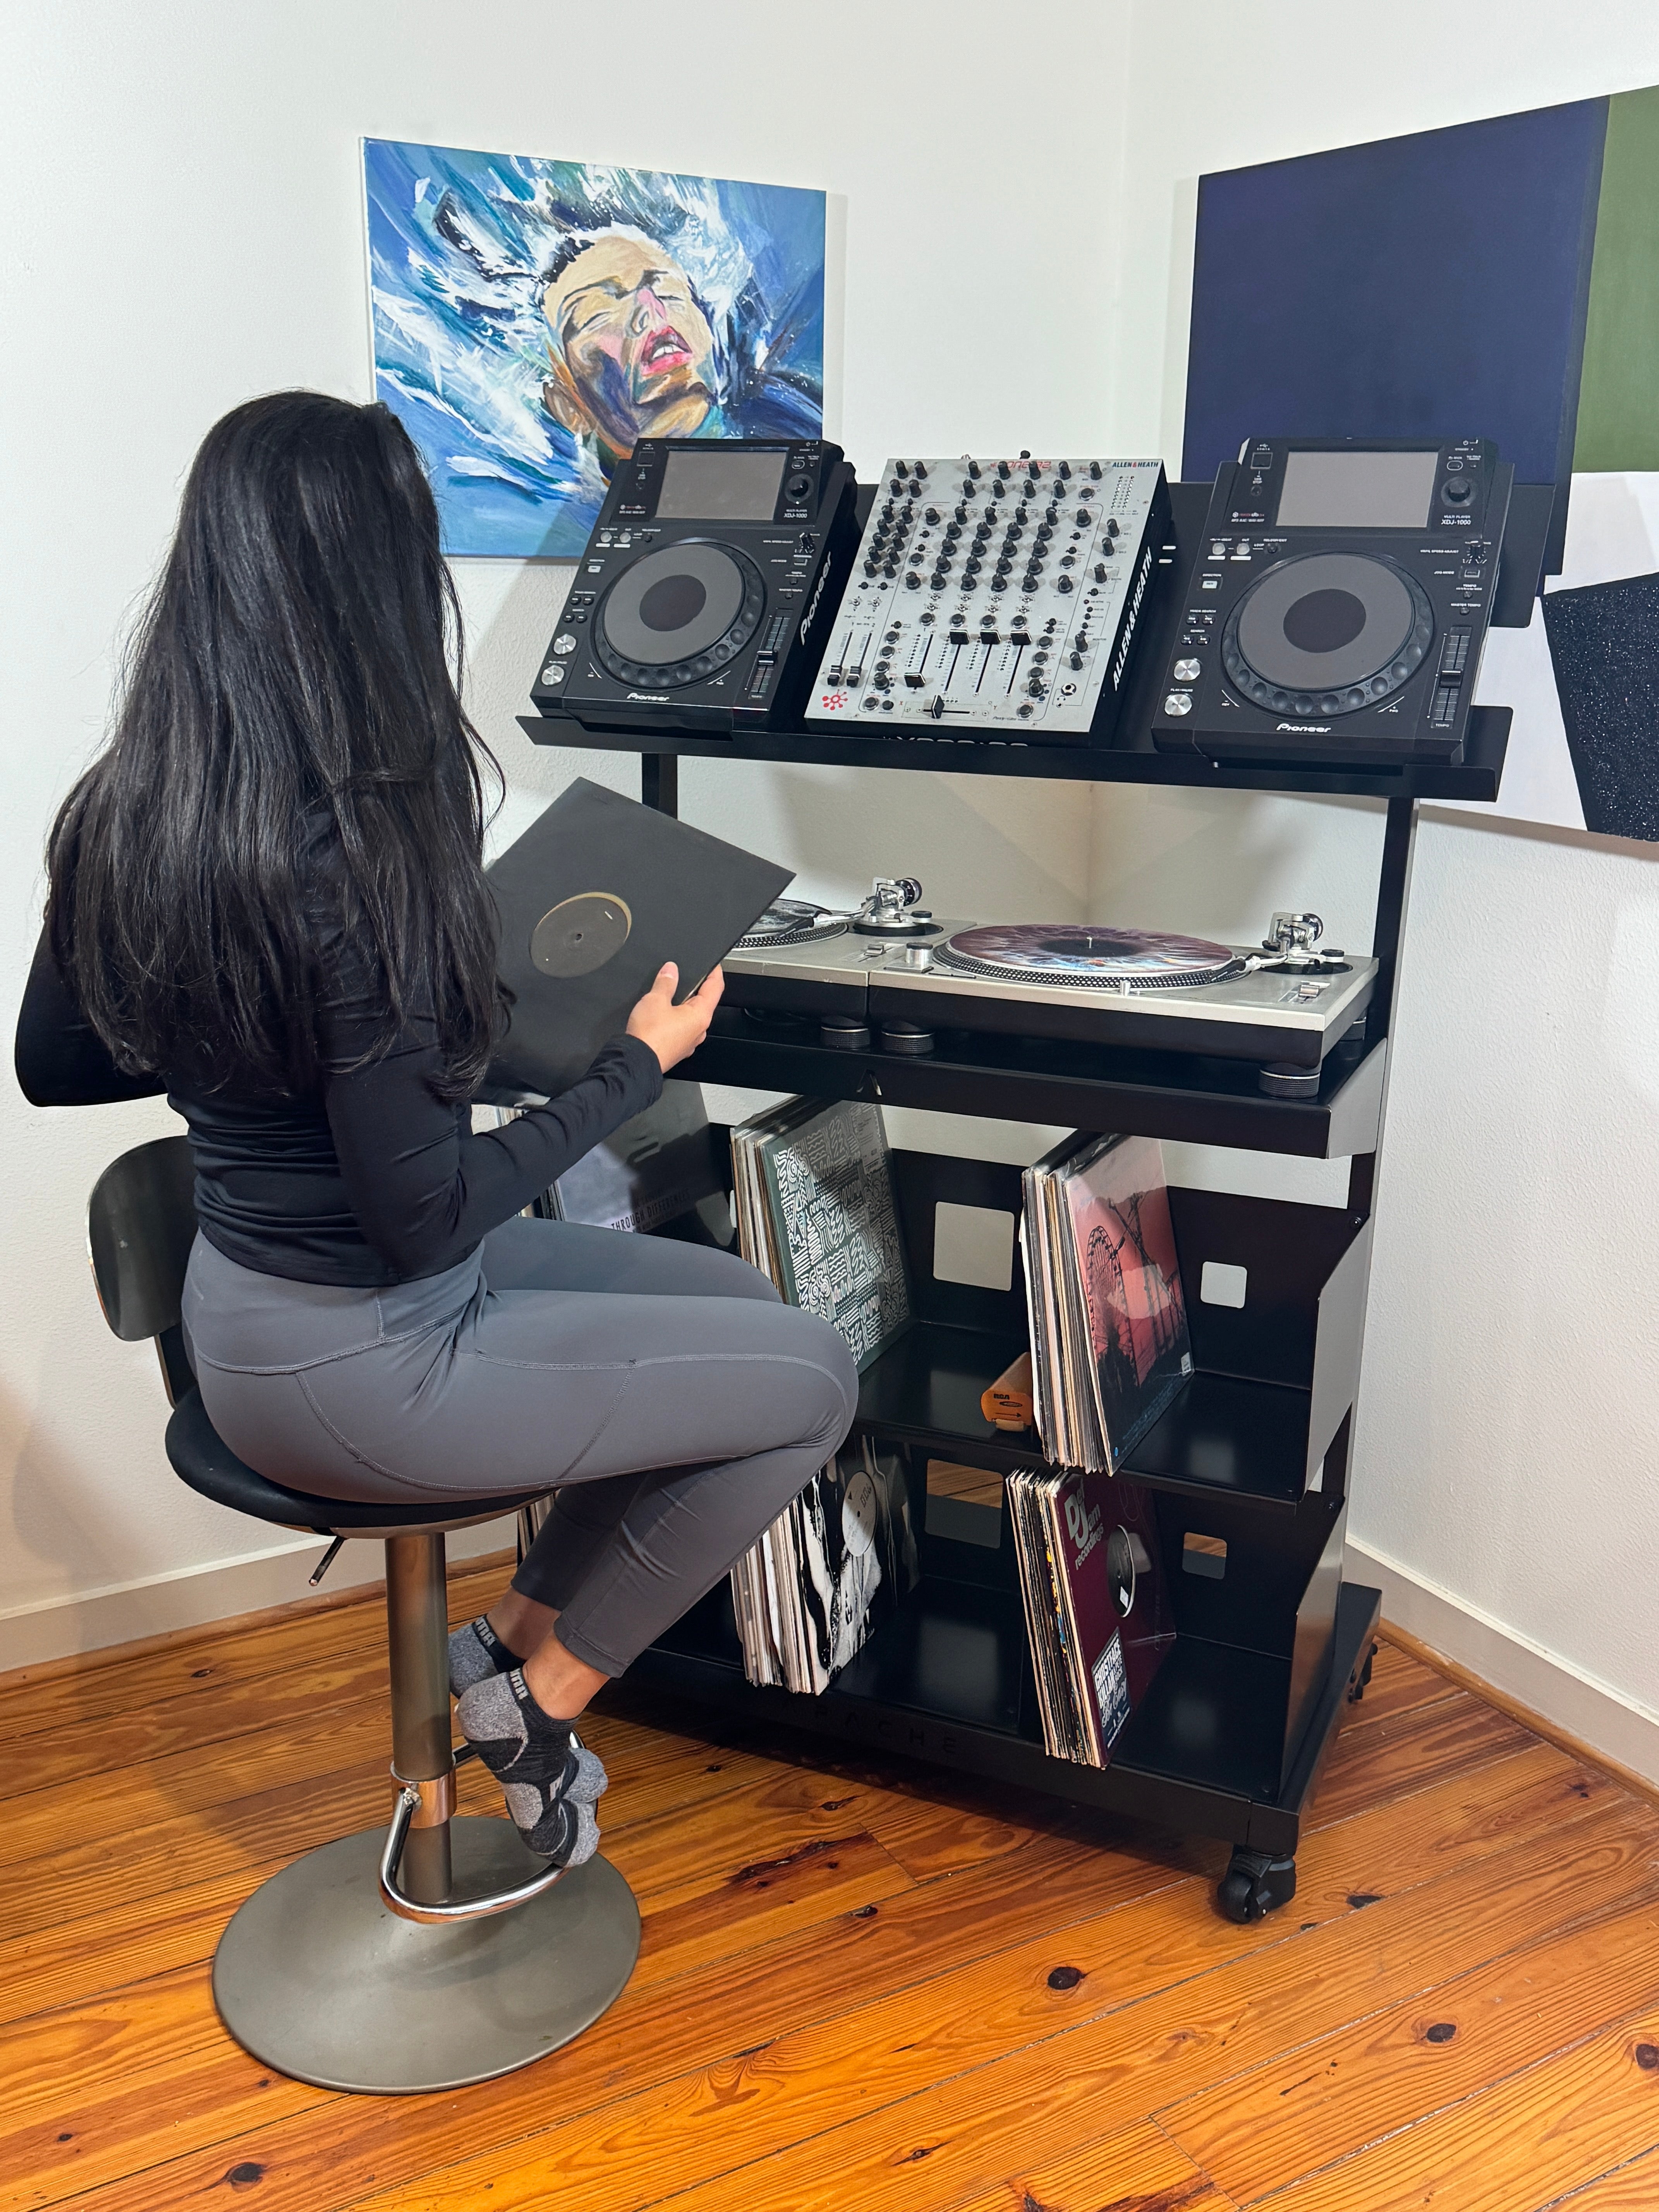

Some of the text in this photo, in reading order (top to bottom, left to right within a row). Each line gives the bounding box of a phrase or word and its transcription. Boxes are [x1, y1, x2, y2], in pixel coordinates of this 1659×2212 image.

[800, 551, 831, 646] Pioneer
[627, 692, 670, 701] Pioneer
[1276, 723, 1331, 733] Pioneer
[611, 1209, 645, 1231] THROUGH
[1074, 1523, 1104, 1571] recordings
[1094, 1638, 1121, 1692] GHOSTFACE
